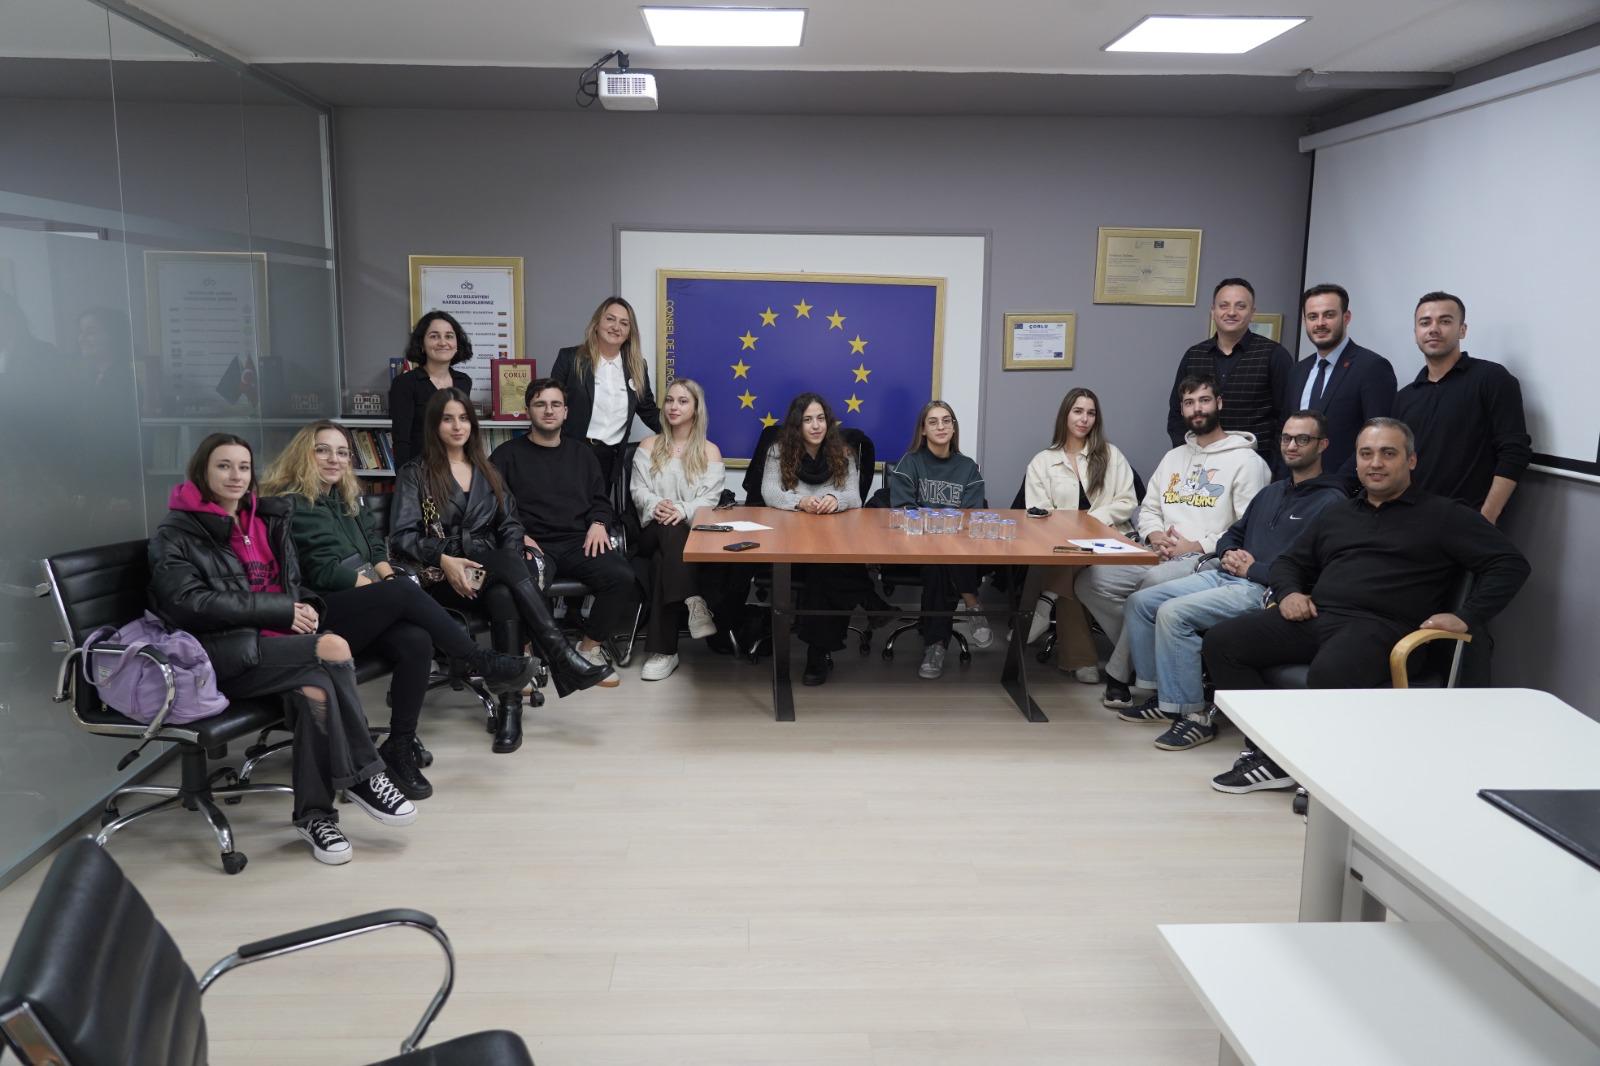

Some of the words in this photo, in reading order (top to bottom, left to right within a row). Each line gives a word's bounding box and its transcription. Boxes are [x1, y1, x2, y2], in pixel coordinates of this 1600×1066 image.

[666, 300, 674, 337] CONSEIL
[666, 339, 675, 350] DE
[919, 478, 963, 507] NIKE
